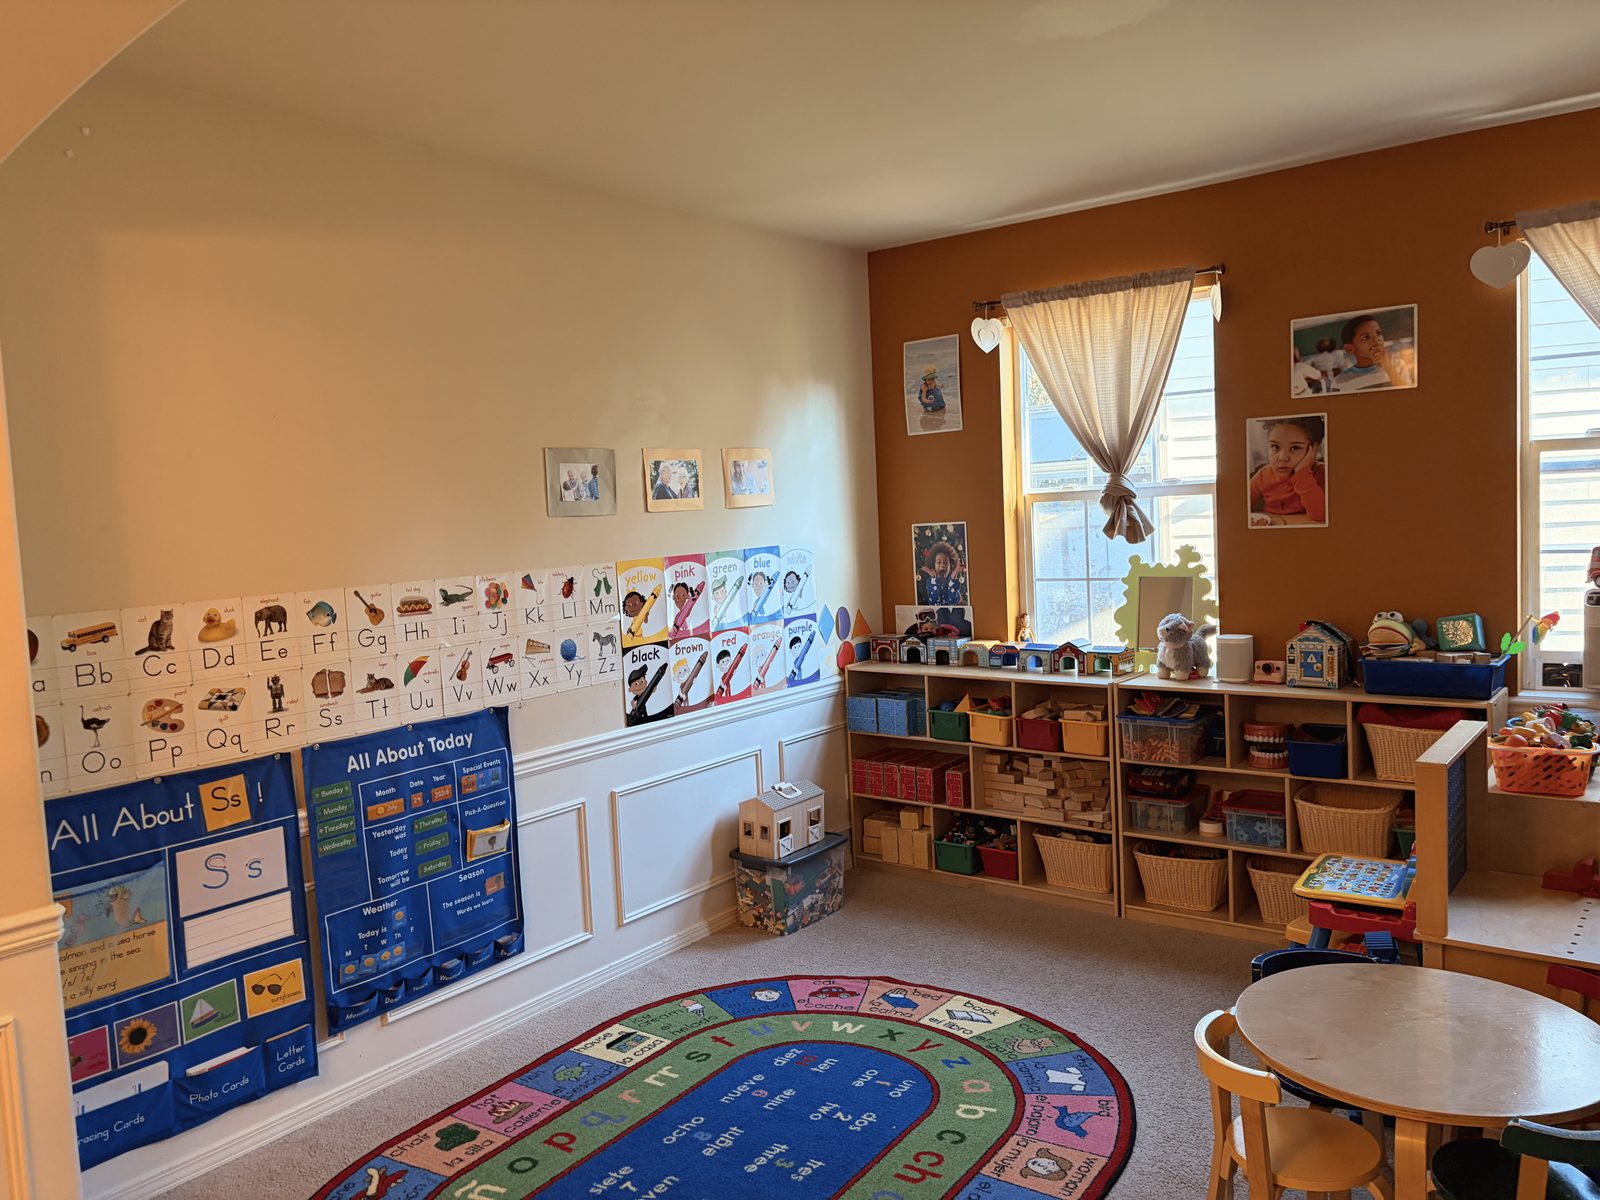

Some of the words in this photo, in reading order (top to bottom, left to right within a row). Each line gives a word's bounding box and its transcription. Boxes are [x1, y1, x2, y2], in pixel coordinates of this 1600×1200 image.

[713, 563, 737, 578] green
[754, 557, 771, 568] blue
[625, 572, 657, 587] yellow
[675, 565, 696, 581] pink
[525, 607, 545, 624] Kk
[589, 599, 615, 616] Mm
[404, 621, 430, 642] Hh
[489, 611, 508, 636] Jj
[789, 621, 813, 637] purple
[312, 632, 338, 654] Ff
[358, 628, 388, 654] Gg
[721, 634, 737, 646] red
[752, 629, 780, 642] orange
[202, 645, 236, 670] Dd
[260, 639, 289, 661] Ee
[631, 648, 660, 663] black
[675, 643, 703, 655] brown
[75, 662, 113, 688] Bb
[142, 655, 177, 677] Cc
[564, 664, 583, 686] Yy
[598, 658, 616, 675] Zz
[487, 677, 517, 695] Ww
[529, 670, 550, 688] Xx
[409, 691, 434, 711] Uu
[453, 684, 473, 702] Vv
[366, 698, 389, 719] Tt
[319, 709, 343, 728] Ss
[265, 718, 295, 739] Rr
[206, 728, 249, 753] Qq
[81, 750, 122, 773] Oo
[149, 738, 183, 767] Pp
[347, 752, 370, 773] All
[376, 741, 425, 766] About
[427, 732, 474, 754] Today
[462, 763, 483, 775] Special
[483, 758, 501, 769] Events
[409, 779, 424, 789] Date
[432, 773, 446, 783] Year
[320, 787, 344, 798] Sunday
[375, 786, 397, 798] Month
[323, 804, 348, 816] Monday
[465, 799, 507, 817] Pick-A-Question
[51, 814, 99, 850] All
[111, 792, 194, 837] About
[211, 786, 242, 812] Ss
[419, 816, 444, 829] Thursday
[324, 822, 349, 834] Tuesday
[372, 825, 407, 839] Yesterday
[394, 832, 407, 841] was
[323, 838, 352, 852] Wednesday
[389, 846, 408, 858] Today
[423, 838, 442, 849] Friday
[423, 860, 448, 873] Saturday
[458, 868, 485, 883] Season
[377, 869, 410, 885] Tomorrow
[401, 876, 410, 885] be
[362, 899, 398, 916] Weather
[442, 901, 454, 910] The
[454, 894, 474, 906] season
[456, 906, 473, 916] Words
[90, 941, 105, 954] and
[116, 936, 131, 946] sea
[133, 929, 156, 941] horse
[357, 928, 380, 941] Today
[69, 961, 97, 975] singing
[110, 951, 123, 961] the
[79, 985, 94, 998] silly
[97, 978, 118, 991] song!
[271, 990, 302, 1004] sunglasses
[912, 988, 944, 1001] bed
[805, 1001, 856, 1011] coche
[963, 1000, 1000, 1017] book
[639, 1008, 684, 1028] cream
[669, 1015, 718, 1037] helado
[929, 1017, 942, 1025] el
[943, 1020, 974, 1036] libro
[1019, 1022, 1044, 1037] cat
[573, 1032, 613, 1053] house
[634, 1039, 664, 1057] casa
[986, 1041, 1018, 1060] gato
[276, 1044, 305, 1061] Letter
[773, 1048, 804, 1068] diez
[795, 1055, 818, 1068] 10
[278, 1056, 306, 1073] Cards
[810, 1057, 839, 1074] ten
[851, 1069, 879, 1088] one
[1016, 1061, 1042, 1092] camisa
[190, 1089, 218, 1105] Photo
[222, 1076, 250, 1094] Cards
[720, 1073, 765, 1105] nueve
[751, 1089, 769, 1099] 9
[888, 1079, 917, 1099] uno
[470, 1093, 501, 1111] hot
[762, 1088, 797, 1111] nine
[1098, 1099, 1115, 1118] bird
[504, 1098, 562, 1134] caliente
[809, 1102, 841, 1121] two
[833, 1111, 853, 1123] 2
[77, 1129, 110, 1145] racing
[114, 1114, 145, 1132] Cards
[662, 1116, 705, 1145] ocho
[849, 1111, 878, 1132] dos
[390, 1131, 432, 1158] chair
[464, 1138, 495, 1157] silla
[702, 1126, 745, 1157] eight
[744, 1143, 790, 1173] three
[774, 1157, 795, 1169] 3
[991, 1147, 1022, 1178] mujer
[790, 1158, 826, 1182] tres
[893, 1151, 945, 1185] ch
[1058, 1156, 1099, 1197] woman
[589, 1166, 634, 1195] siete
[619, 1181, 638, 1193] 7
[975, 1180, 992, 1195] el
